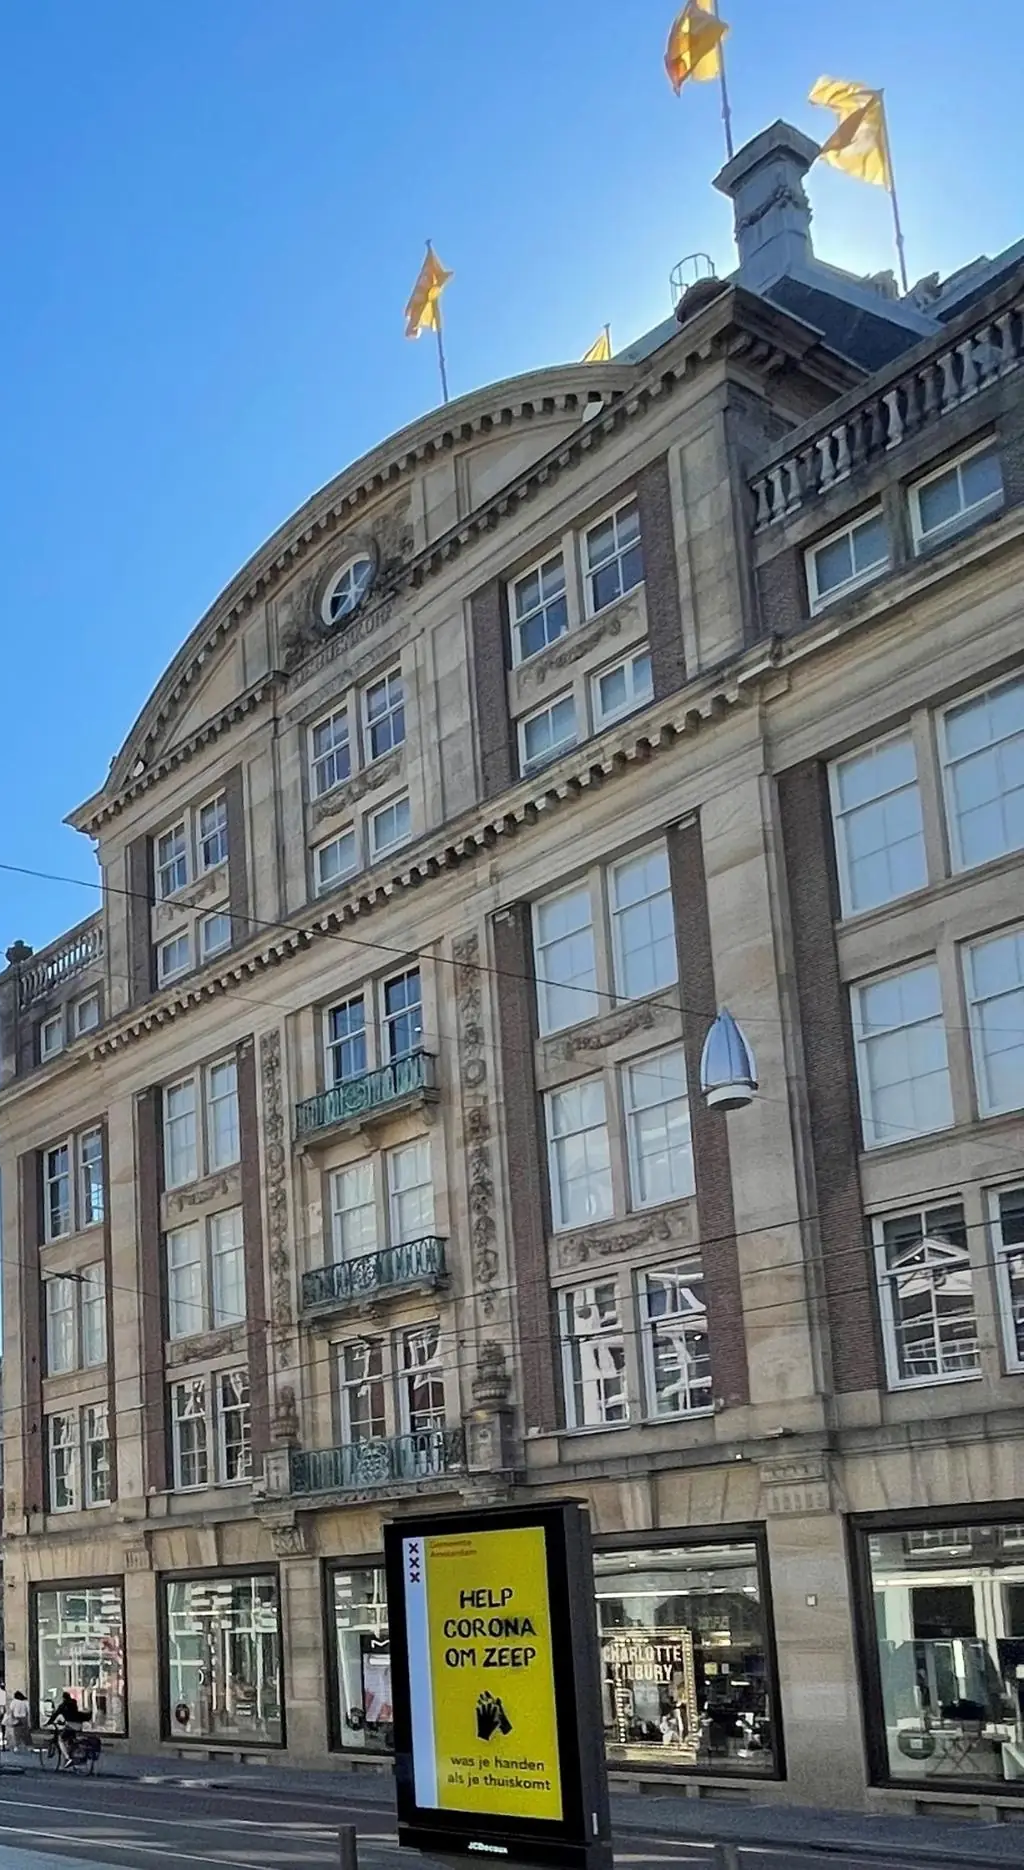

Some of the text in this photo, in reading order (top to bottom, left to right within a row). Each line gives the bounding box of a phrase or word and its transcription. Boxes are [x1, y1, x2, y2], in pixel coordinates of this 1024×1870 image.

[459, 1588, 513, 1608] HELP
[443, 1617, 537, 1638] CORONA
[445, 1647, 537, 1667] OM ZEEP
[602, 1644, 682, 1662] CHARLOTTE
[611, 1663, 673, 1681] TILBURY
[450, 1756, 545, 1772] was je handen
[447, 1772, 551, 1790] als je thuiskomt
